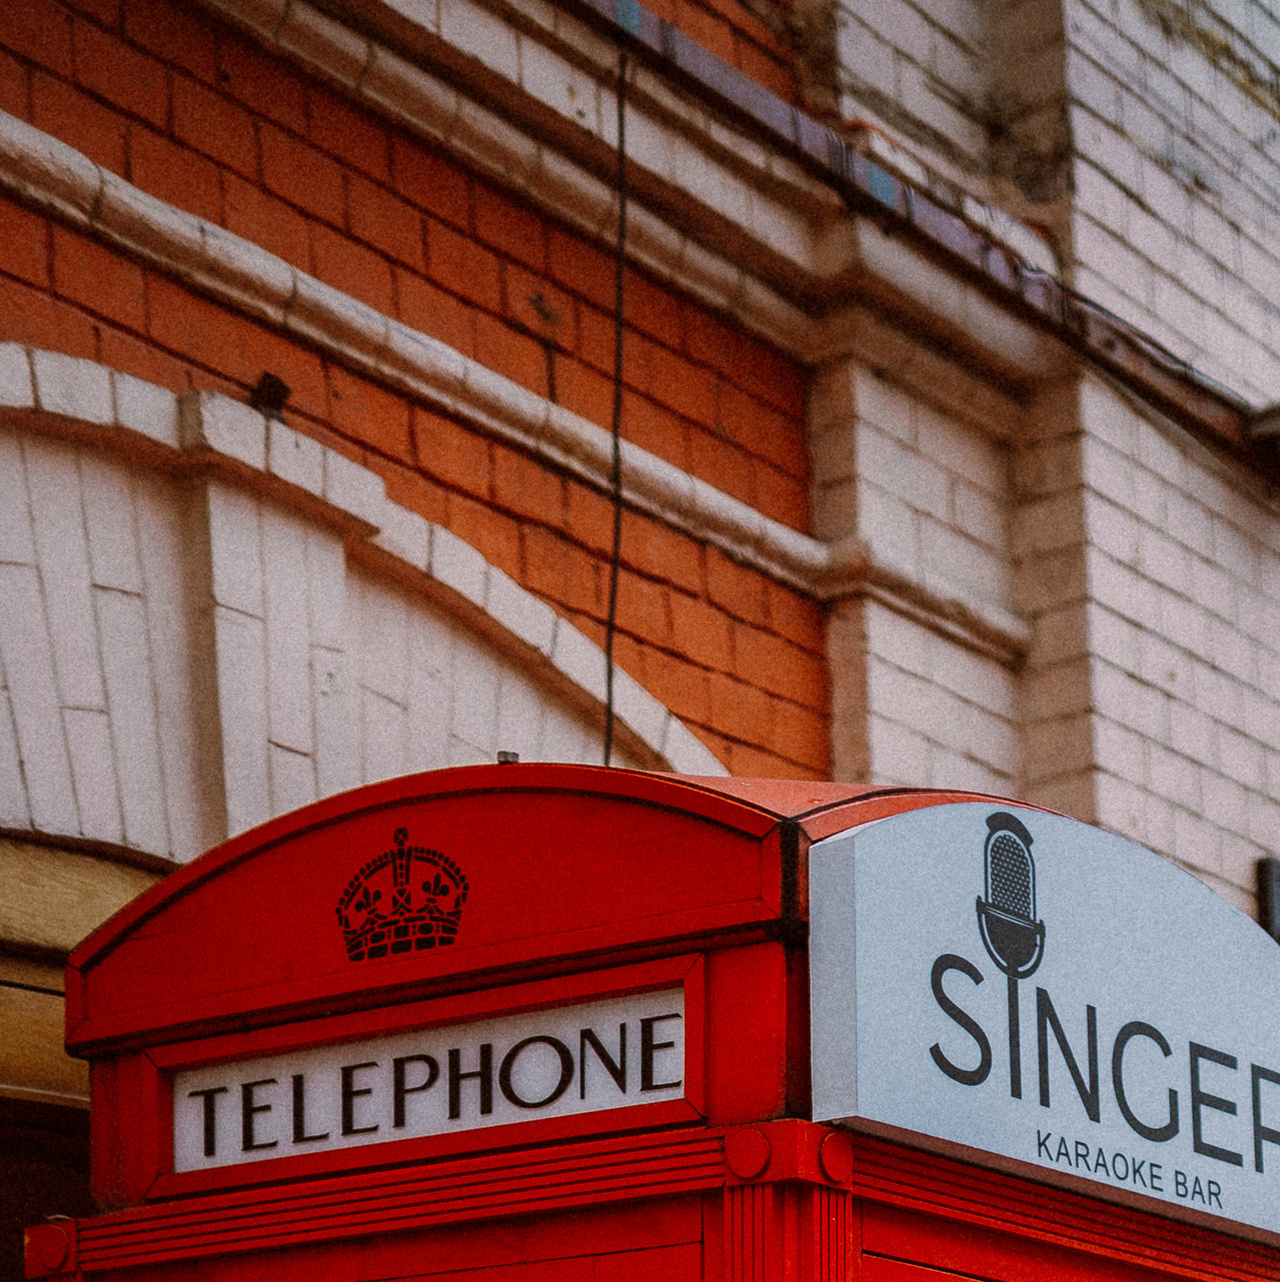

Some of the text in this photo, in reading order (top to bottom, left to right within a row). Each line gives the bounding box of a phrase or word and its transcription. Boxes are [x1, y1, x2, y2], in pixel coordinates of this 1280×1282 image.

[188, 1012, 683, 1157] TELEPHONE
[1036, 1129, 1223, 1209] KARAOKE BAR
